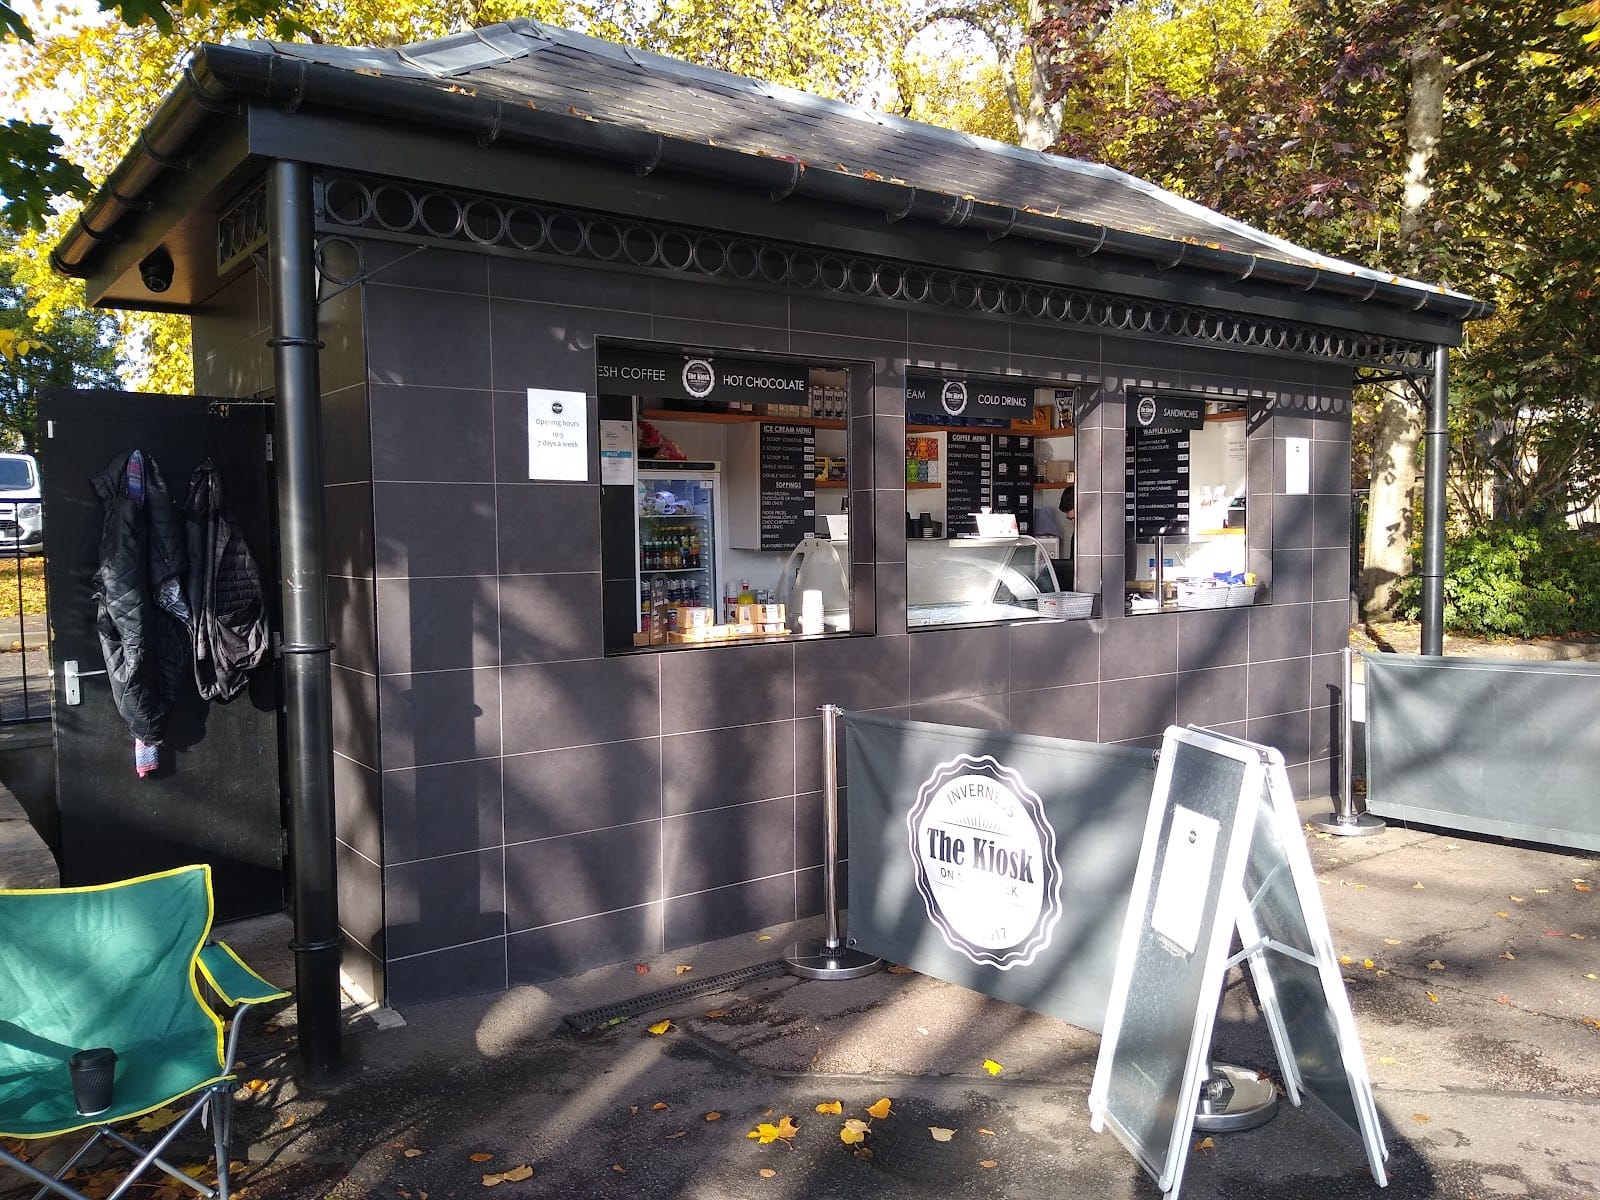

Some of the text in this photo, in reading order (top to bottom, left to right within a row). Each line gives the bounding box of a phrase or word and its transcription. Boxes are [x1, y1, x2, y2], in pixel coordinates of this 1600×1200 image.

[620, 366, 666, 381] COFFEE
[687, 372, 697, 380] The
[723, 375, 805, 391] HOT CHOCOLATE
[906, 389, 926, 400] EAM
[977, 394, 1027, 407] COLD DRINKS
[1163, 408, 1199, 419] SANDWICHES
[535, 418, 562, 428] Opening
[763, 425, 812, 434] ICE CREAM MENU
[1142, 427, 1164, 436] WAFFLE
[542, 439, 557, 447] days
[775, 481, 802, 489] TOPPINGS
[946, 783, 1015, 818] INVERNES
[926, 828, 1034, 884] The Kiosk
[940, 867, 954, 880] ON
